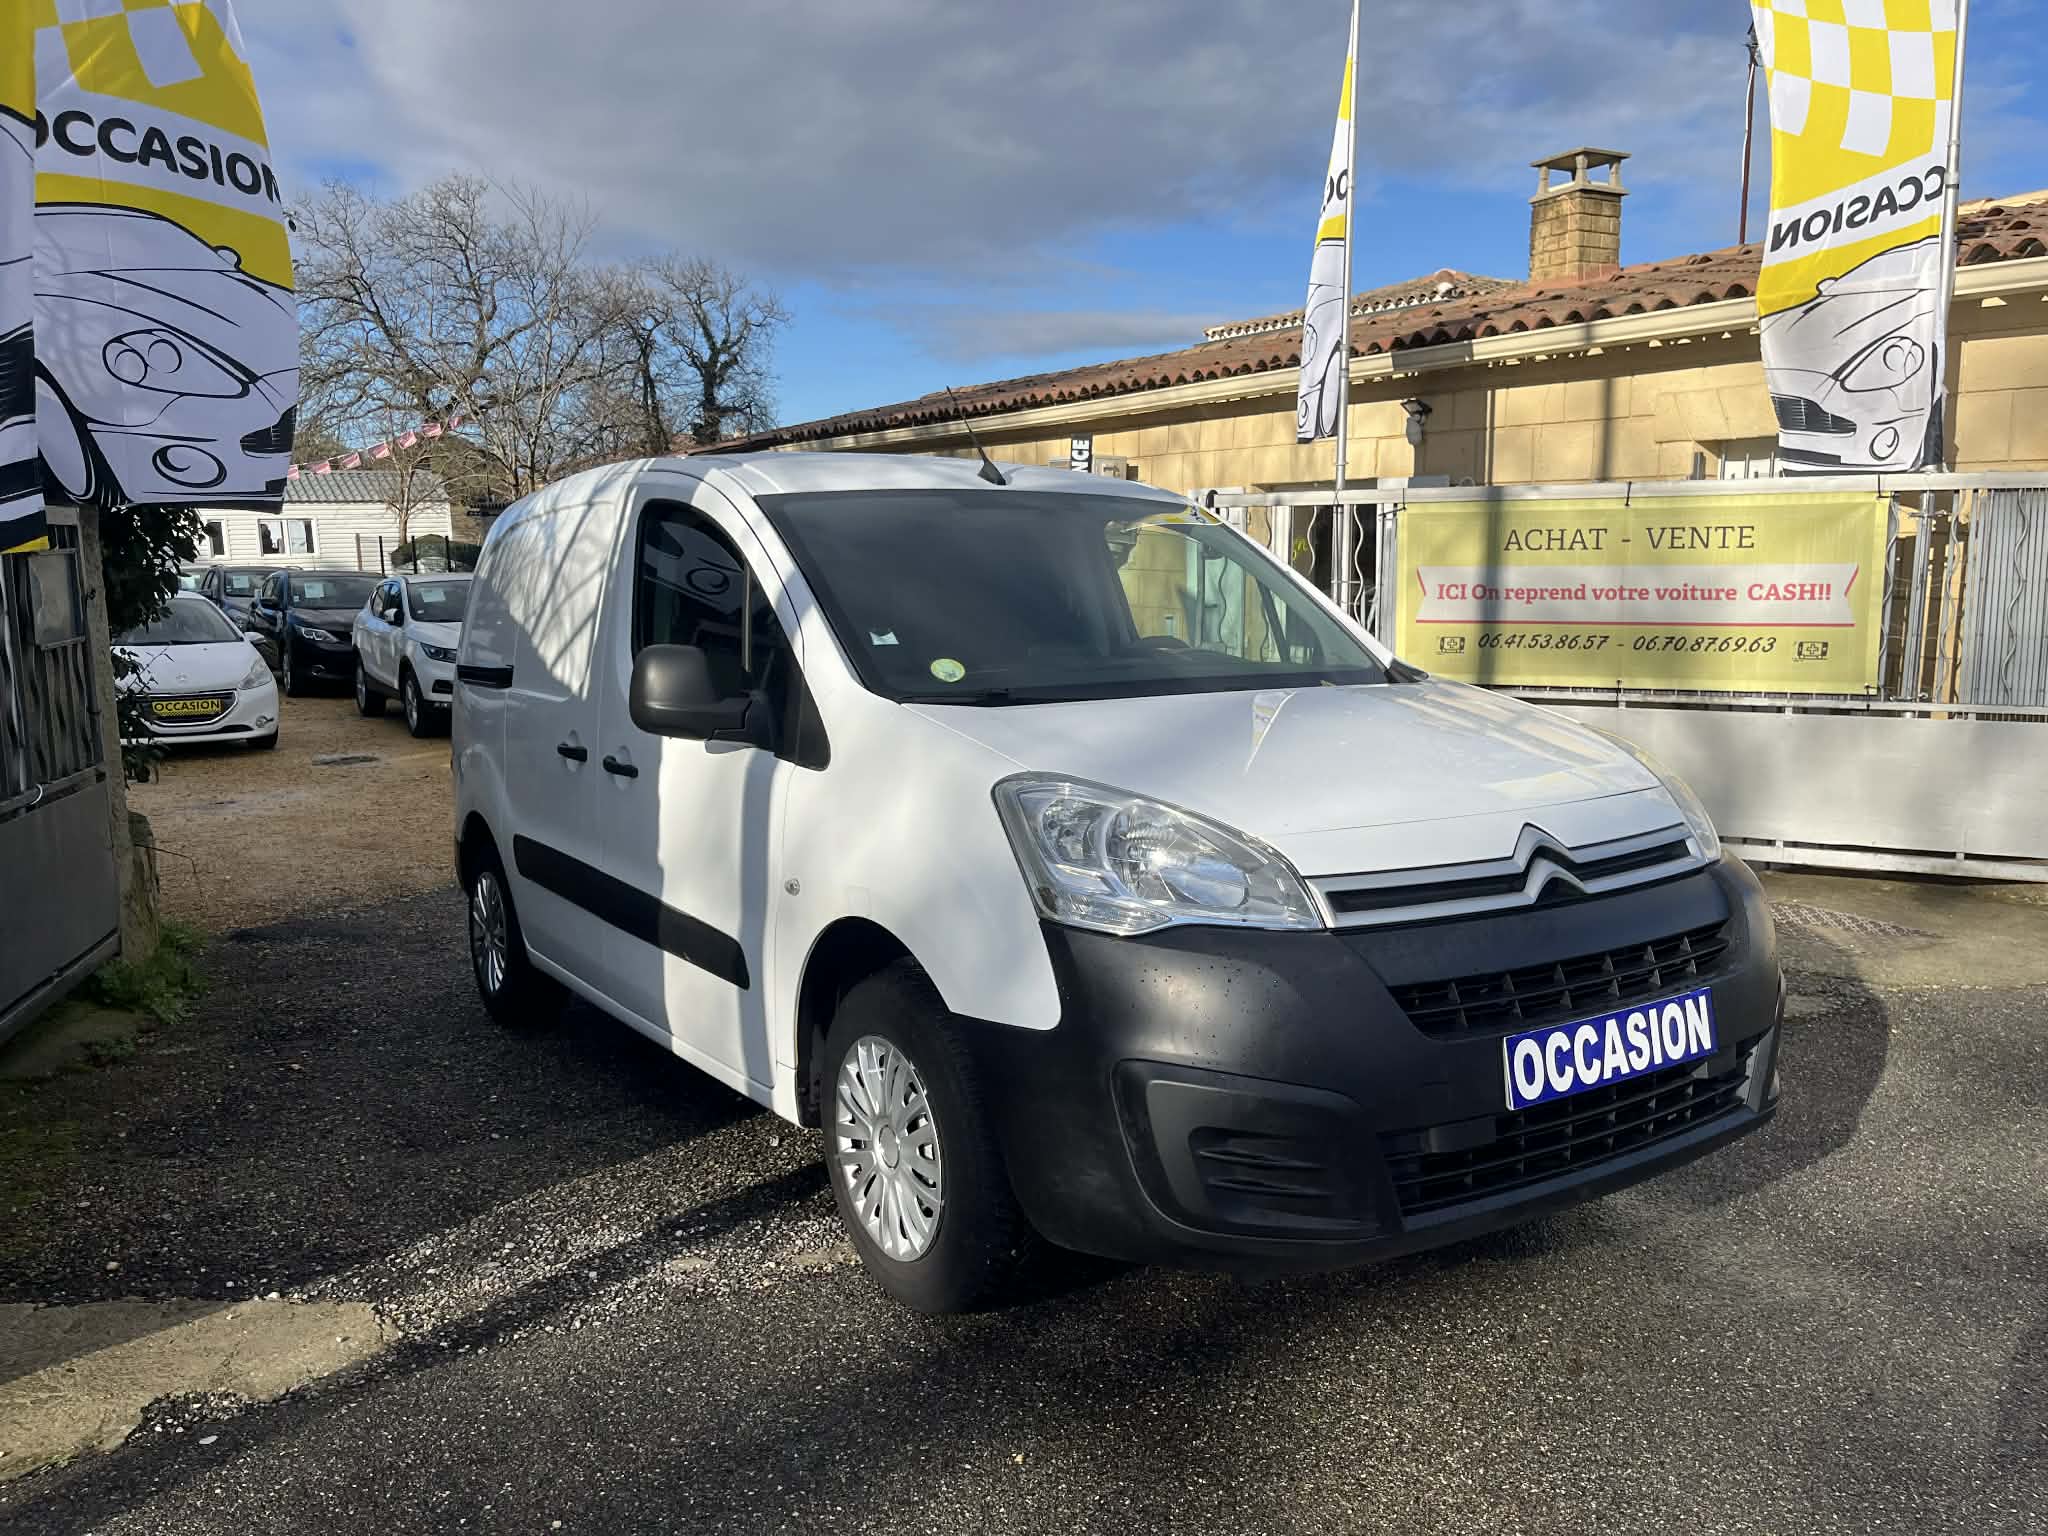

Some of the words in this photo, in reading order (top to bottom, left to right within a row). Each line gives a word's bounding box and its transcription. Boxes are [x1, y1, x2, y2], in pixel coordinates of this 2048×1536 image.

[1503, 528, 1608, 551] ACHAT
[1646, 526, 1755, 550] VENTE
[1437, 583, 1467, 600] ICI
[1471, 583, 1500, 601] On
[1504, 583, 1586, 605] reprend
[1592, 587, 1649, 601] votre
[1655, 583, 1737, 601] voiture
[1747, 583, 1832, 601] CASH!!
[1478, 633, 1610, 650] 06.41.53.86.57
[1632, 635, 1777, 653] 06.70.87.69.63
[154, 700, 220, 712] OCCASION
[1513, 995, 1712, 1101] OCCASION
